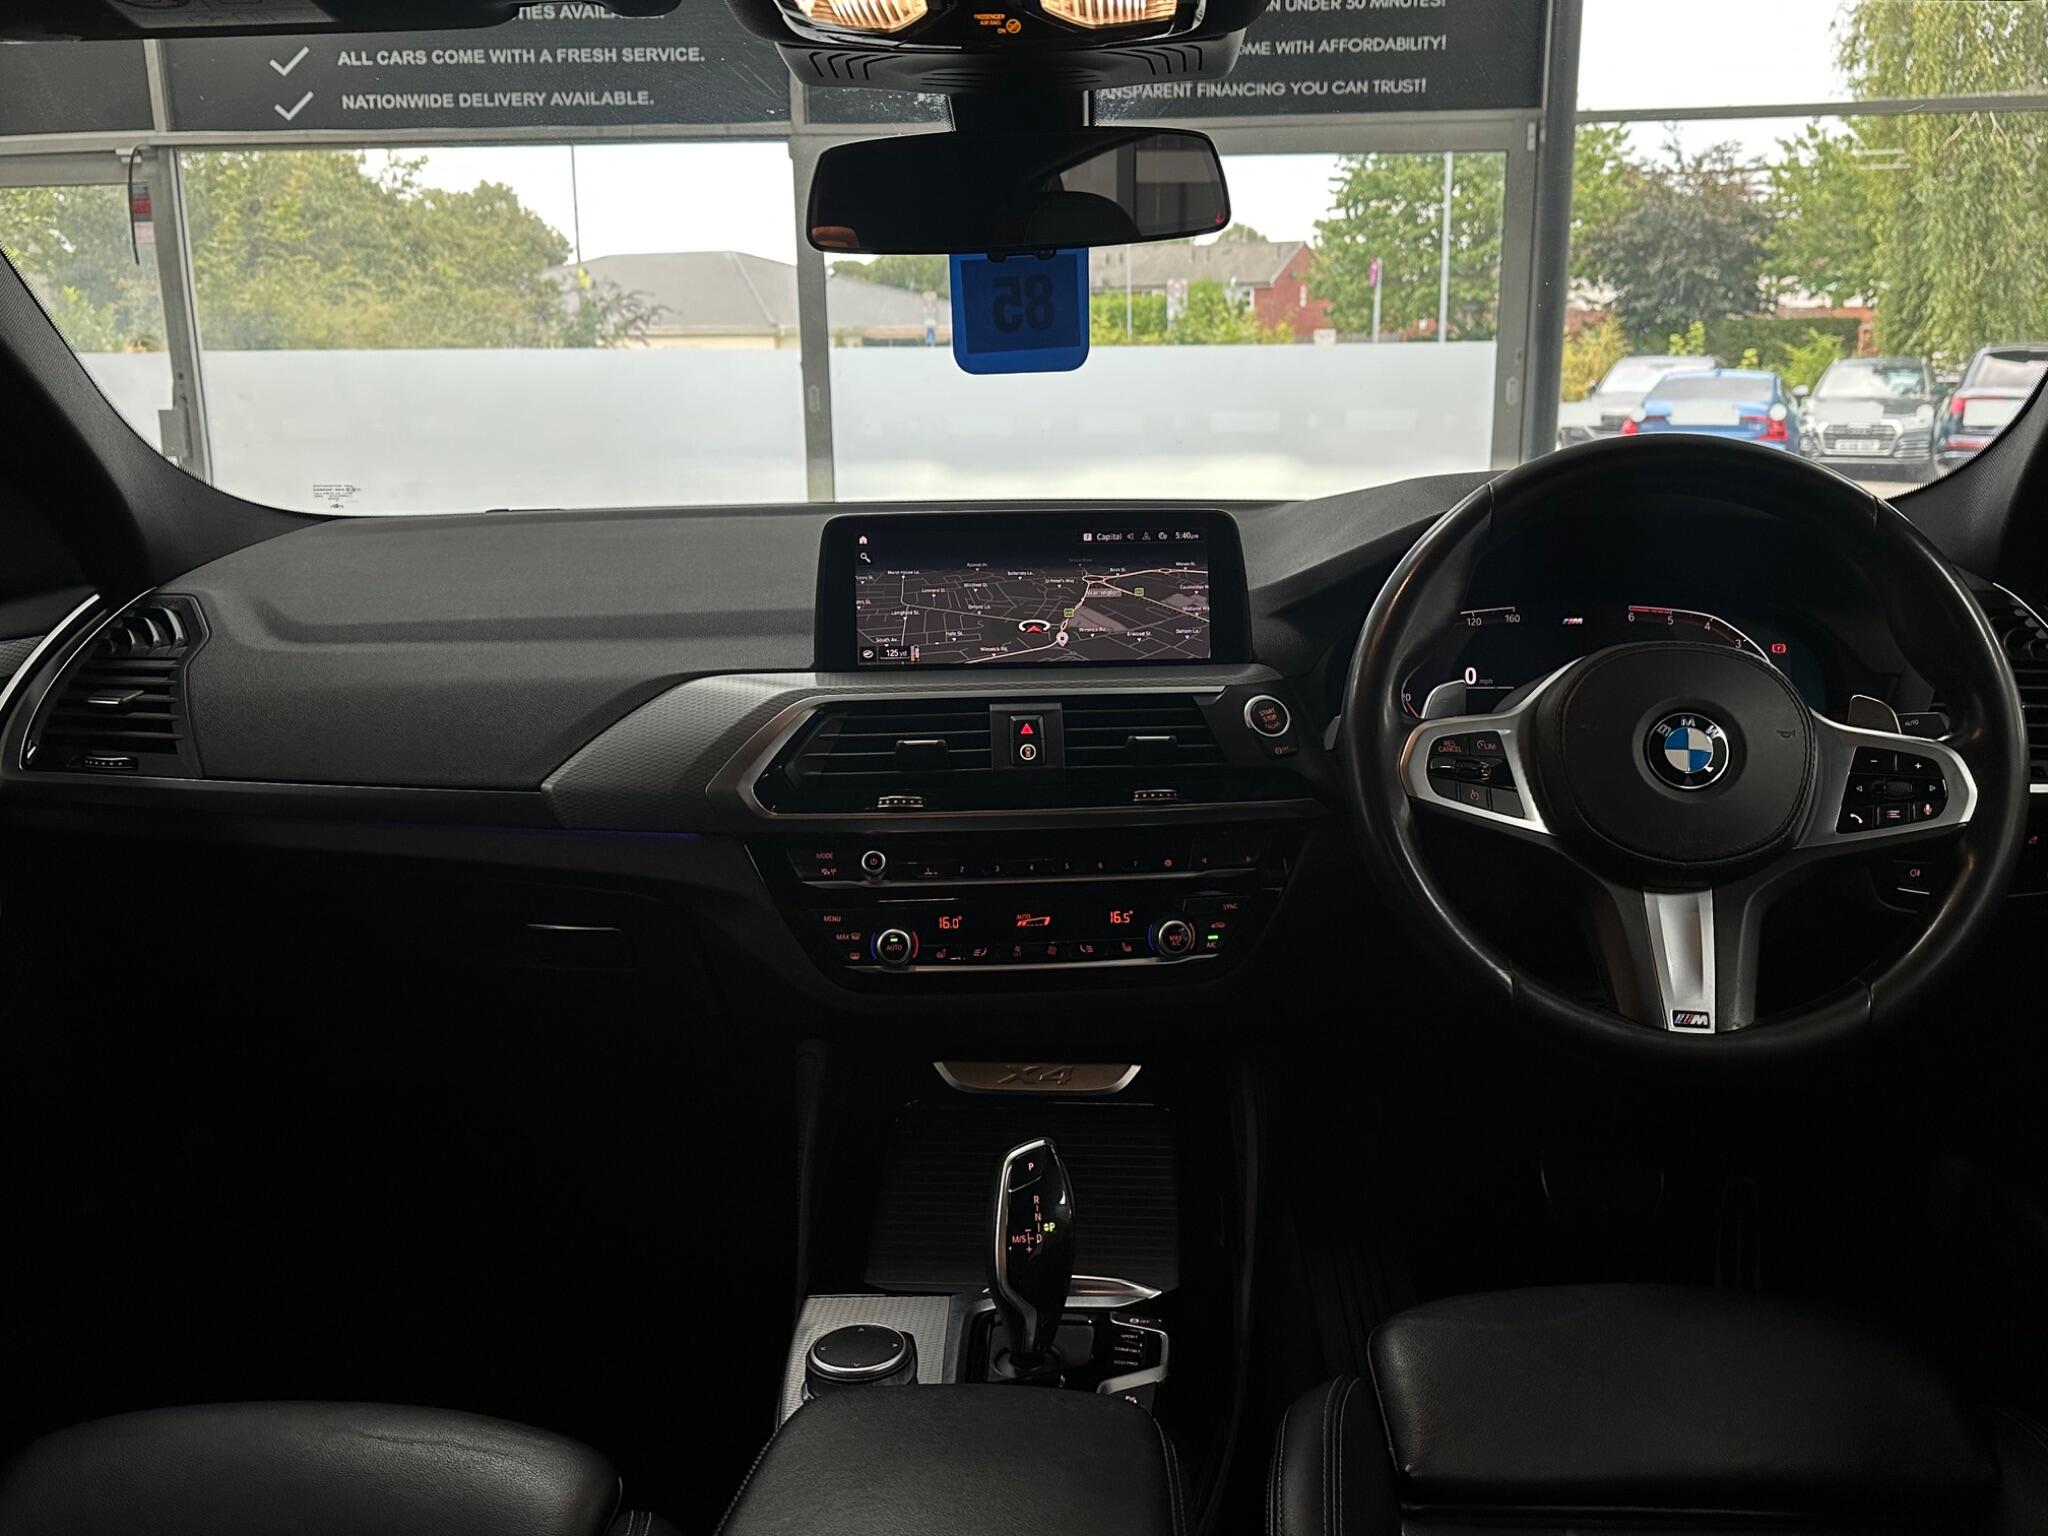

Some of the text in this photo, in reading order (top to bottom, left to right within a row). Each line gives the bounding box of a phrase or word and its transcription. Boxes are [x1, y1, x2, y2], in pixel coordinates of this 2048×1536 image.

[1285, 0, 1341, 12] UNDER
[1275, 40, 1314, 55] WITH
[1318, 34, 1447, 53] AFFORDABILITY!
[338, 46, 705, 66] ALL CARS COME WITH A FRESH SERVICE.
[1197, 82, 1286, 98] FINANCING
[1290, 80, 1328, 96] YOU
[1331, 79, 1368, 95] CAN
[1371, 78, 1427, 94] TRUST!
[342, 91, 654, 110] NATIONWIDE DELIVERY AVAILABLE.
[1096, 532, 1123, 542] Capital
[1467, 614, 1521, 627] 120 160
[1627, 612, 1636, 623] 6
[1667, 616, 1674, 626] 5
[1704, 621, 1711, 631] 4
[1735, 639, 1742, 649] 3
[886, 648, 899, 657] 125
[1464, 666, 1477, 685] 0
[1657, 715, 1720, 739] BMW
[1904, 719, 1920, 727] AUTO
[823, 915, 842, 923] MENU
[886, 944, 903, 952] AUTO
[997, 1065, 1074, 1085] X4
[1028, 1162, 1034, 1171] P
[1034, 1195, 1040, 1204] R
[1035, 1212, 1042, 1222] N
[1036, 1233, 1043, 1243] D
